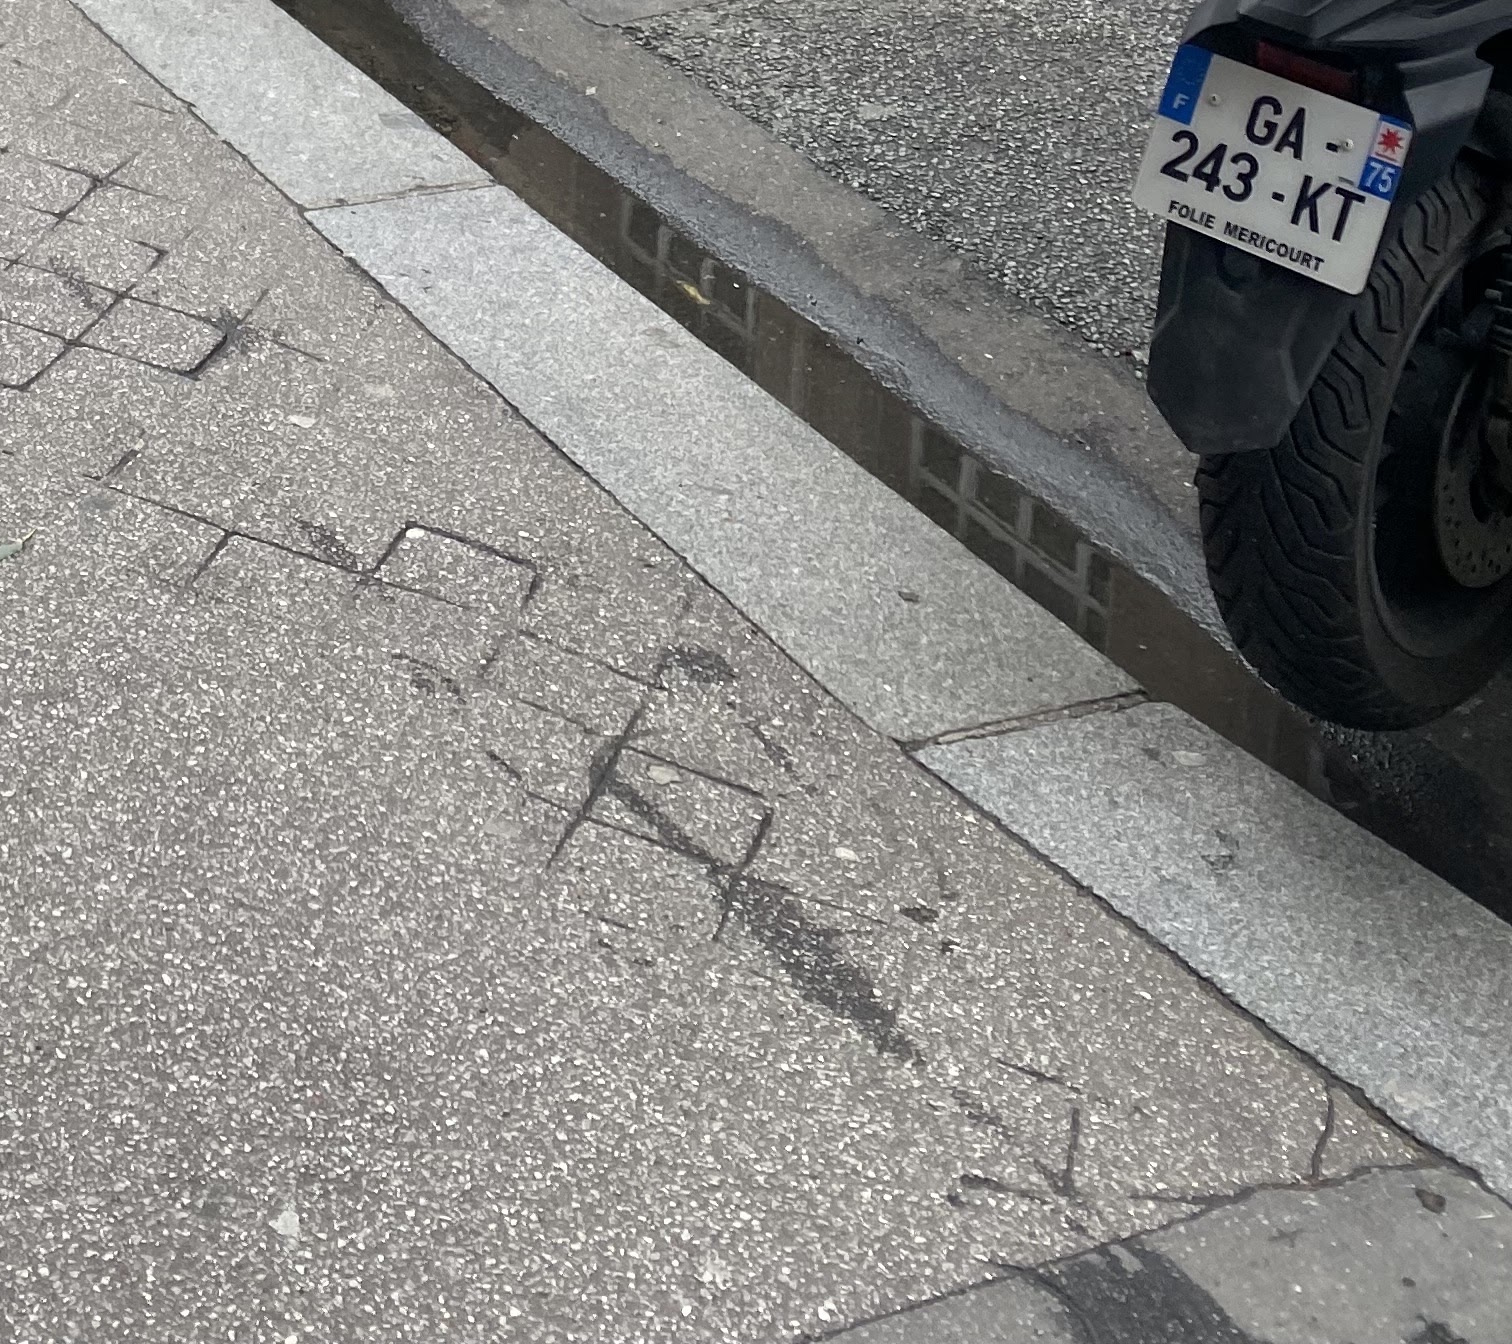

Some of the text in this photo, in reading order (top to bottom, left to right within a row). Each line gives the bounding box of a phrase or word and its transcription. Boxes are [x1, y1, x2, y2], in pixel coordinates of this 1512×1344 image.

[1159, 130, 1366, 242] 243-KT
[1172, 93, 1189, 110] F
[1364, 161, 1397, 193] 75
[1168, 199, 1326, 273] FOLIE MERICOURT
